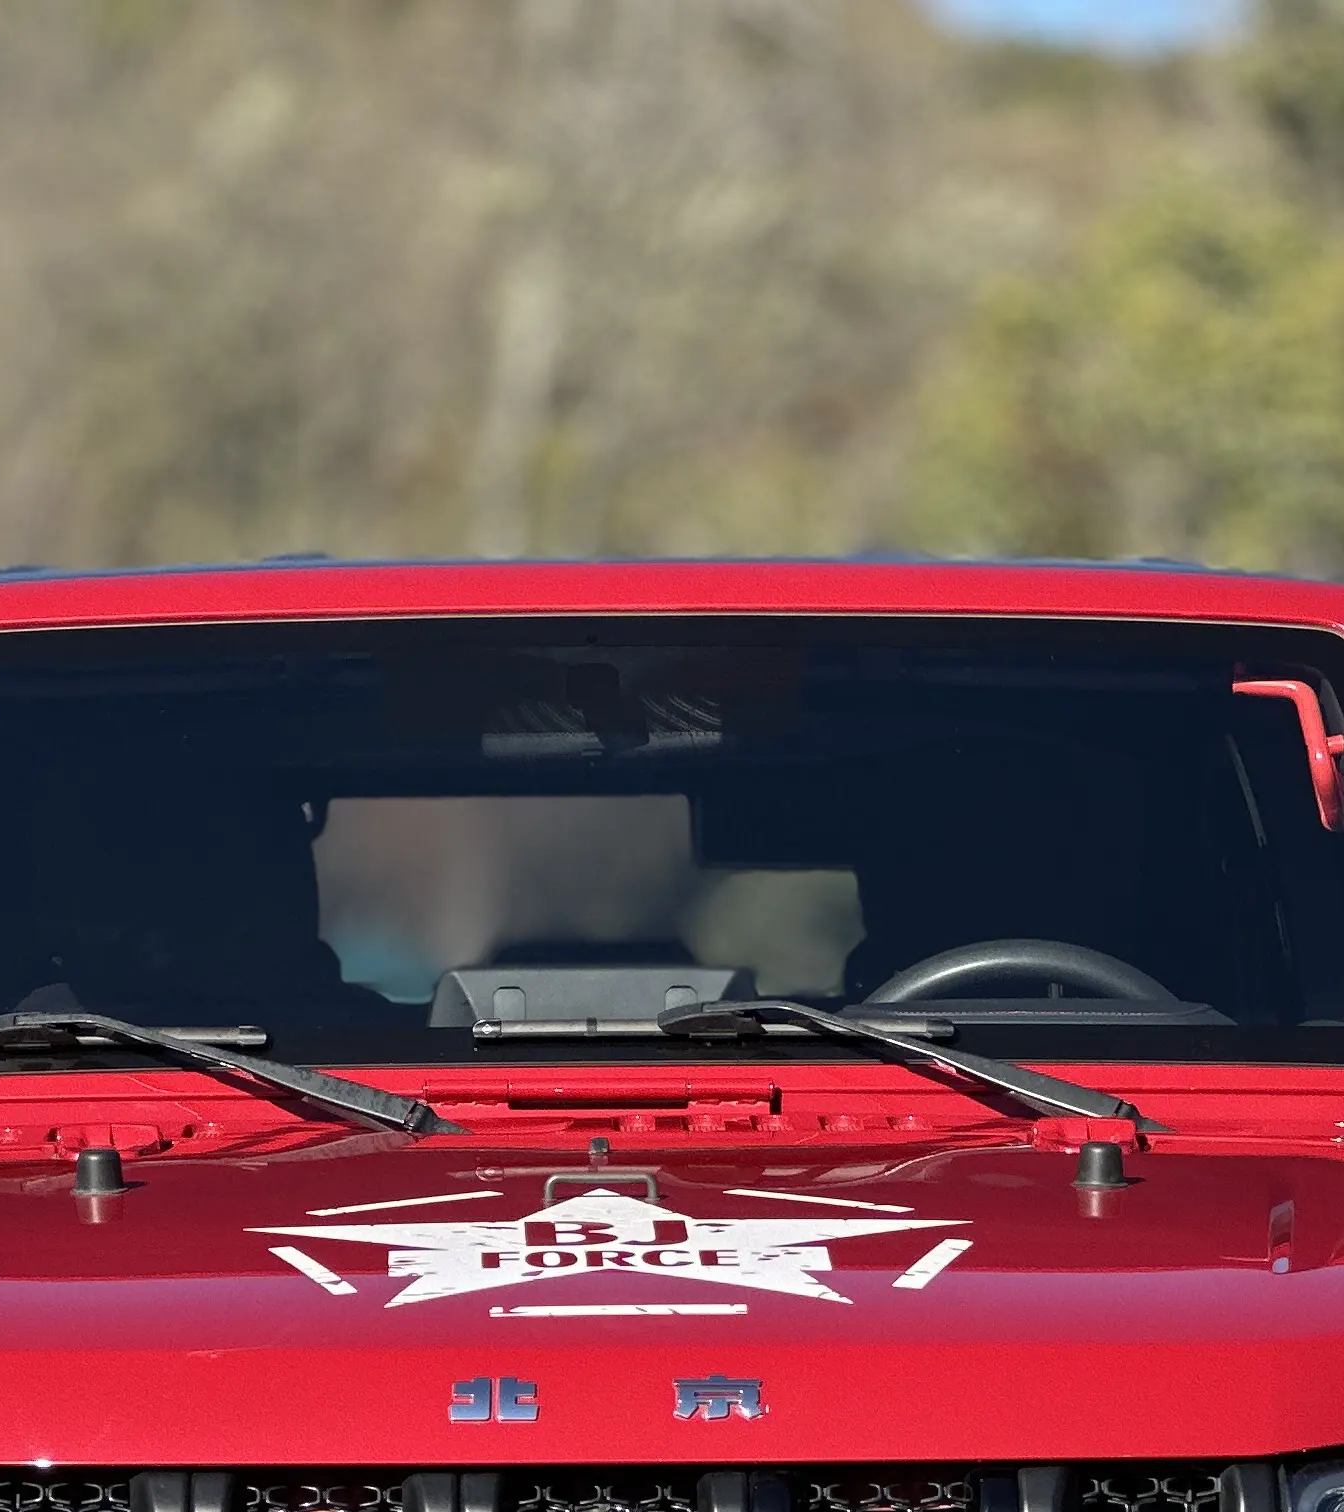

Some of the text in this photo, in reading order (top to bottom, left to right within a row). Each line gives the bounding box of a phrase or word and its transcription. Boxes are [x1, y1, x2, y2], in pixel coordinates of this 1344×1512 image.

[524, 1220, 689, 1246] BJ
[481, 1250, 740, 1268] FORCE
[448, 1374, 764, 1423] 北京
